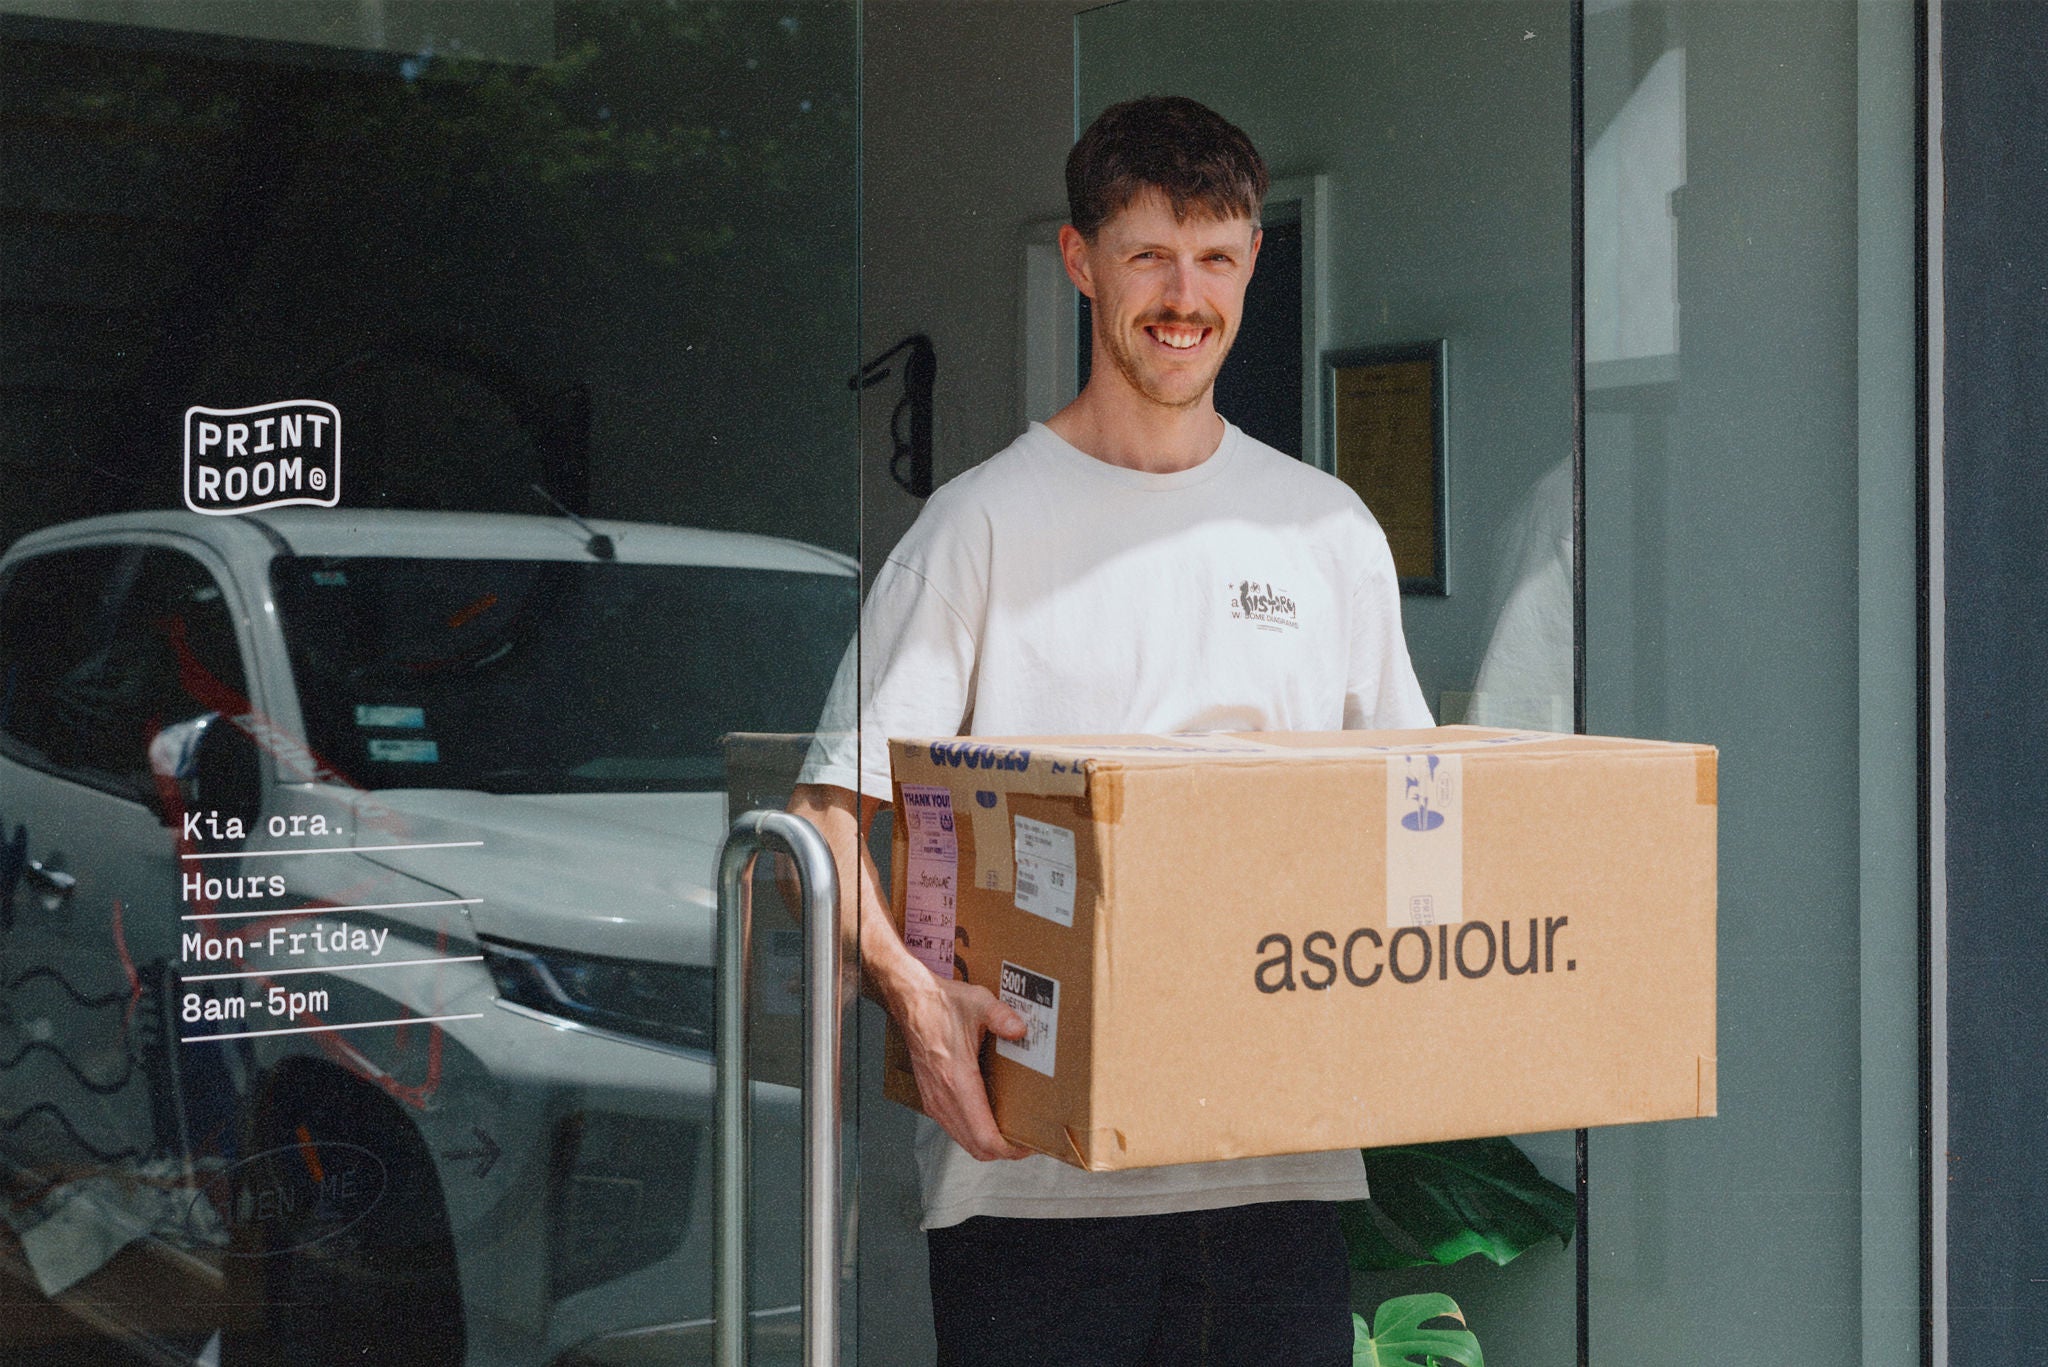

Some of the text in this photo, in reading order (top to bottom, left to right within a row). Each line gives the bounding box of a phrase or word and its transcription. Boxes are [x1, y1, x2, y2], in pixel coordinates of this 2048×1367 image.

[198, 414, 330, 458] PRINT
[198, 457, 303, 501] ROOM
[904, 792, 931, 807] THANK
[183, 811, 344, 841] Kia ora.
[182, 872, 286, 901] Hours
[182, 922, 389, 962] Mon-Friday
[1254, 915, 1577, 994] ascolour.
[1001, 969, 1027, 997] 5001
[182, 986, 330, 1023] 8am-5pm
